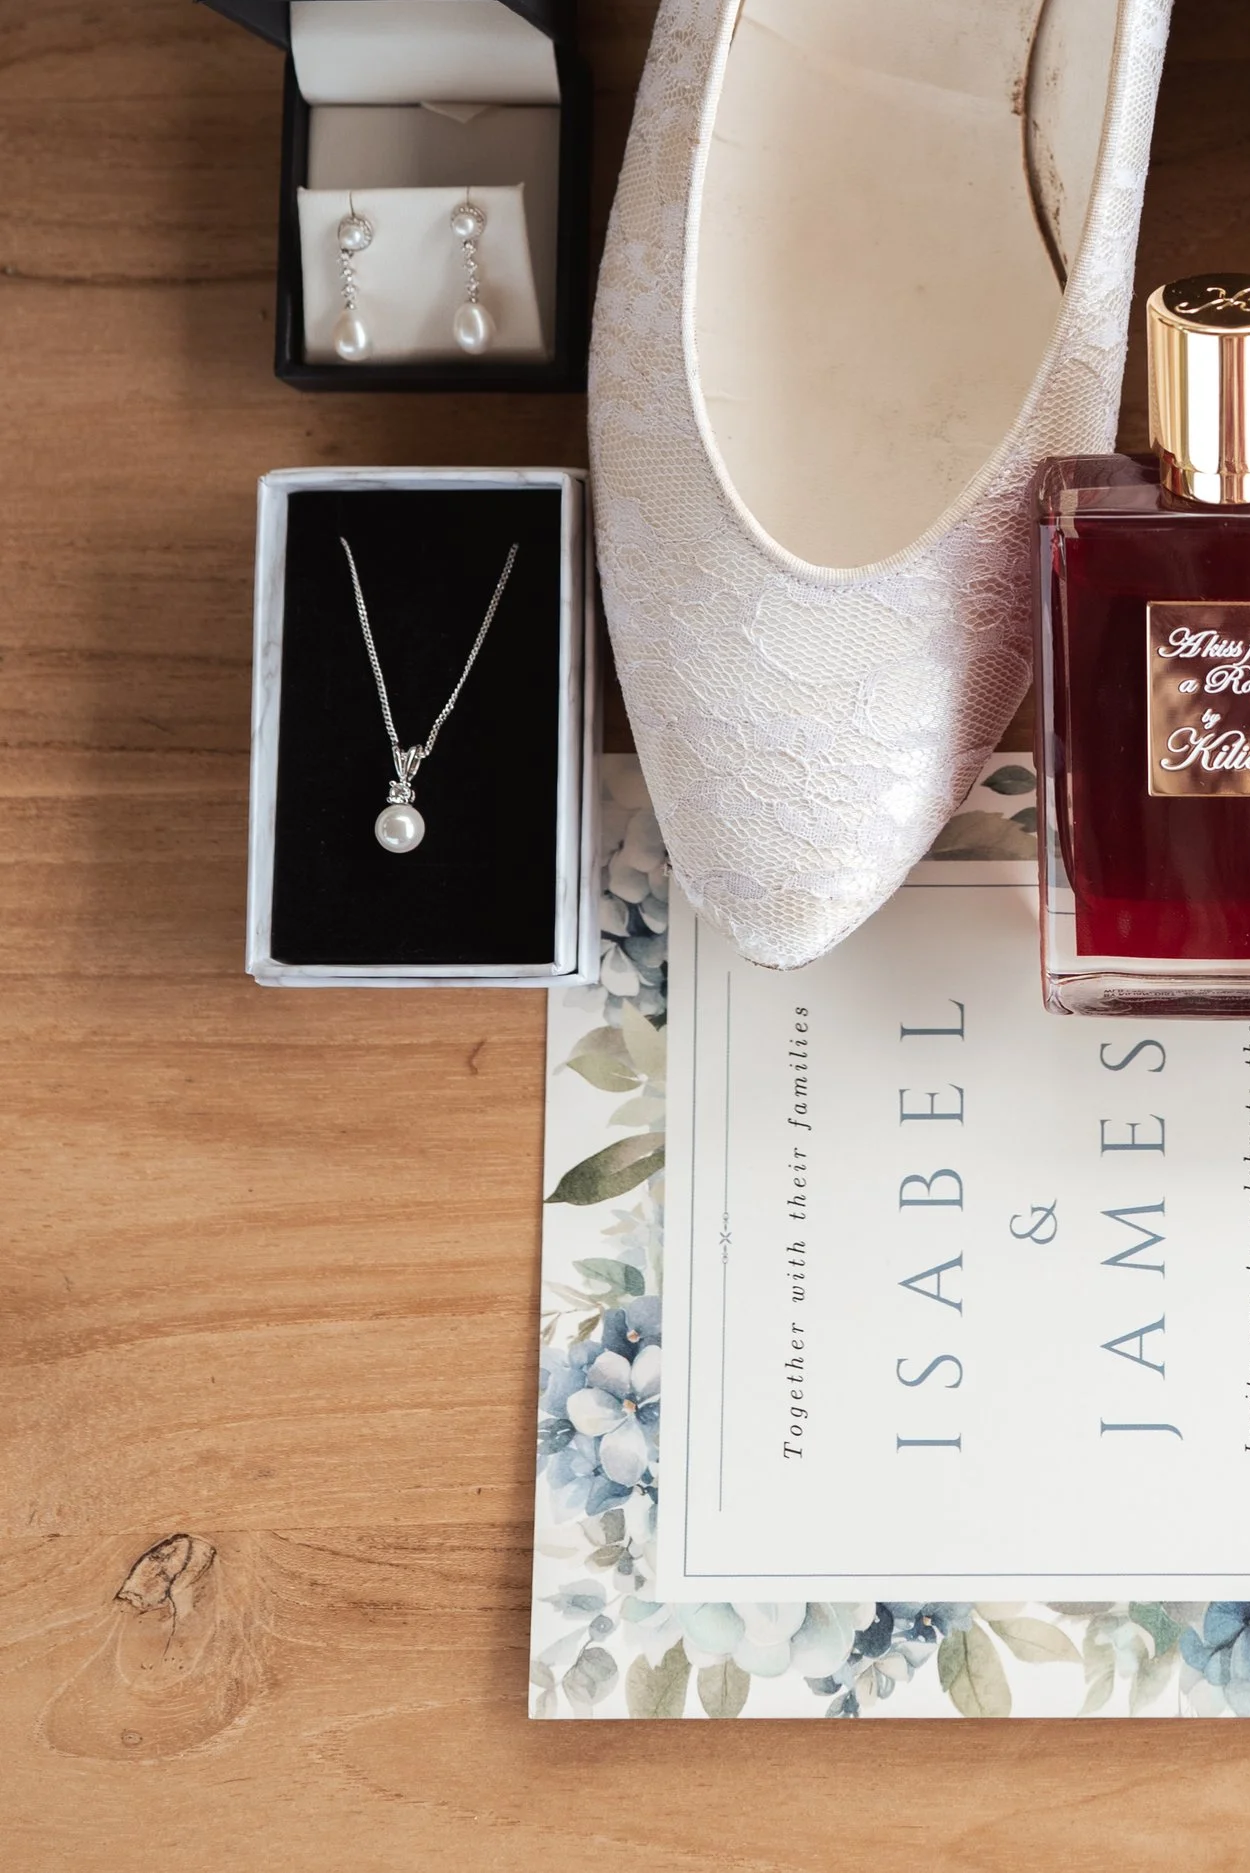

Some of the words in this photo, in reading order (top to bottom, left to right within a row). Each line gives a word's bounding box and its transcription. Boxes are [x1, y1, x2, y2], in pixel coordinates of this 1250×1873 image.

[1158, 626, 1217, 658] A
[1202, 631, 1244, 659] kiss
[1178, 677, 1200, 694] a
[1201, 708, 1222, 730] by
[786, 1006, 813, 1132] families
[786, 1146, 808, 1221] their
[895, 999, 965, 1453] ISABEL
[1010, 1199, 1058, 1245] &
[1100, 1039, 1183, 1440] JAMES
[785, 1240, 806, 1303] with
[782, 1321, 809, 1460] Together
